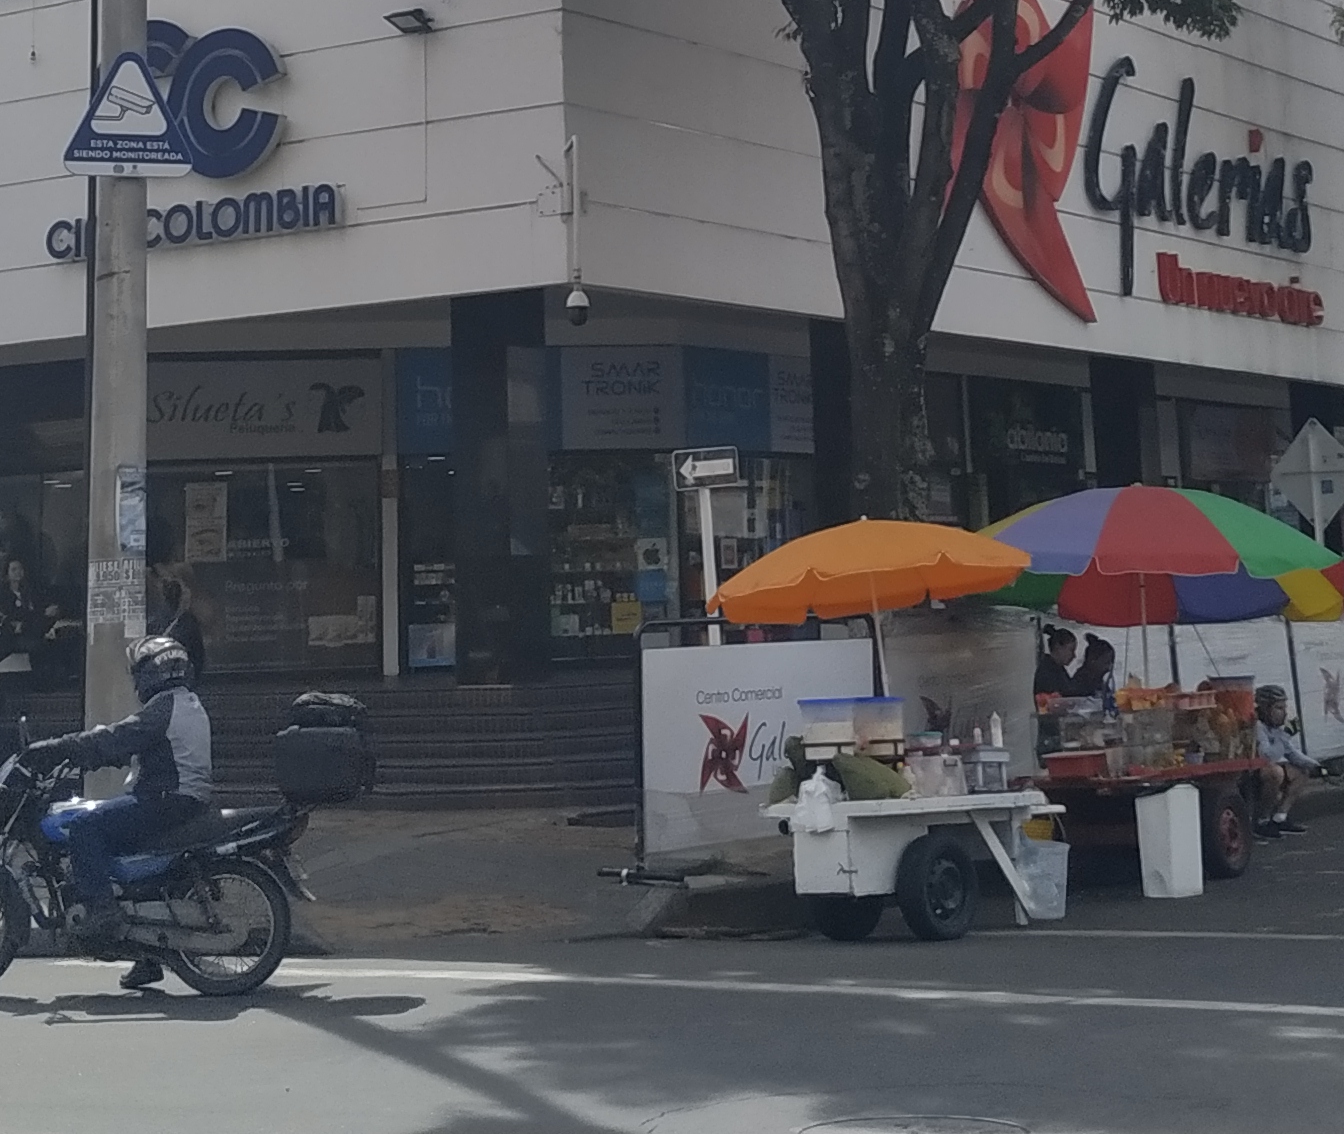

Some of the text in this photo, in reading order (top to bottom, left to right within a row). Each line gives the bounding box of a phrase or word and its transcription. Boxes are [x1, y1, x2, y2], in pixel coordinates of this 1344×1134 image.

[89, 138, 171, 150] ESTA ZONA ESTÁ
[72, 149, 184, 161] SIENDO MONITOREADA
[695, 686, 783, 705] Centro Comercial
